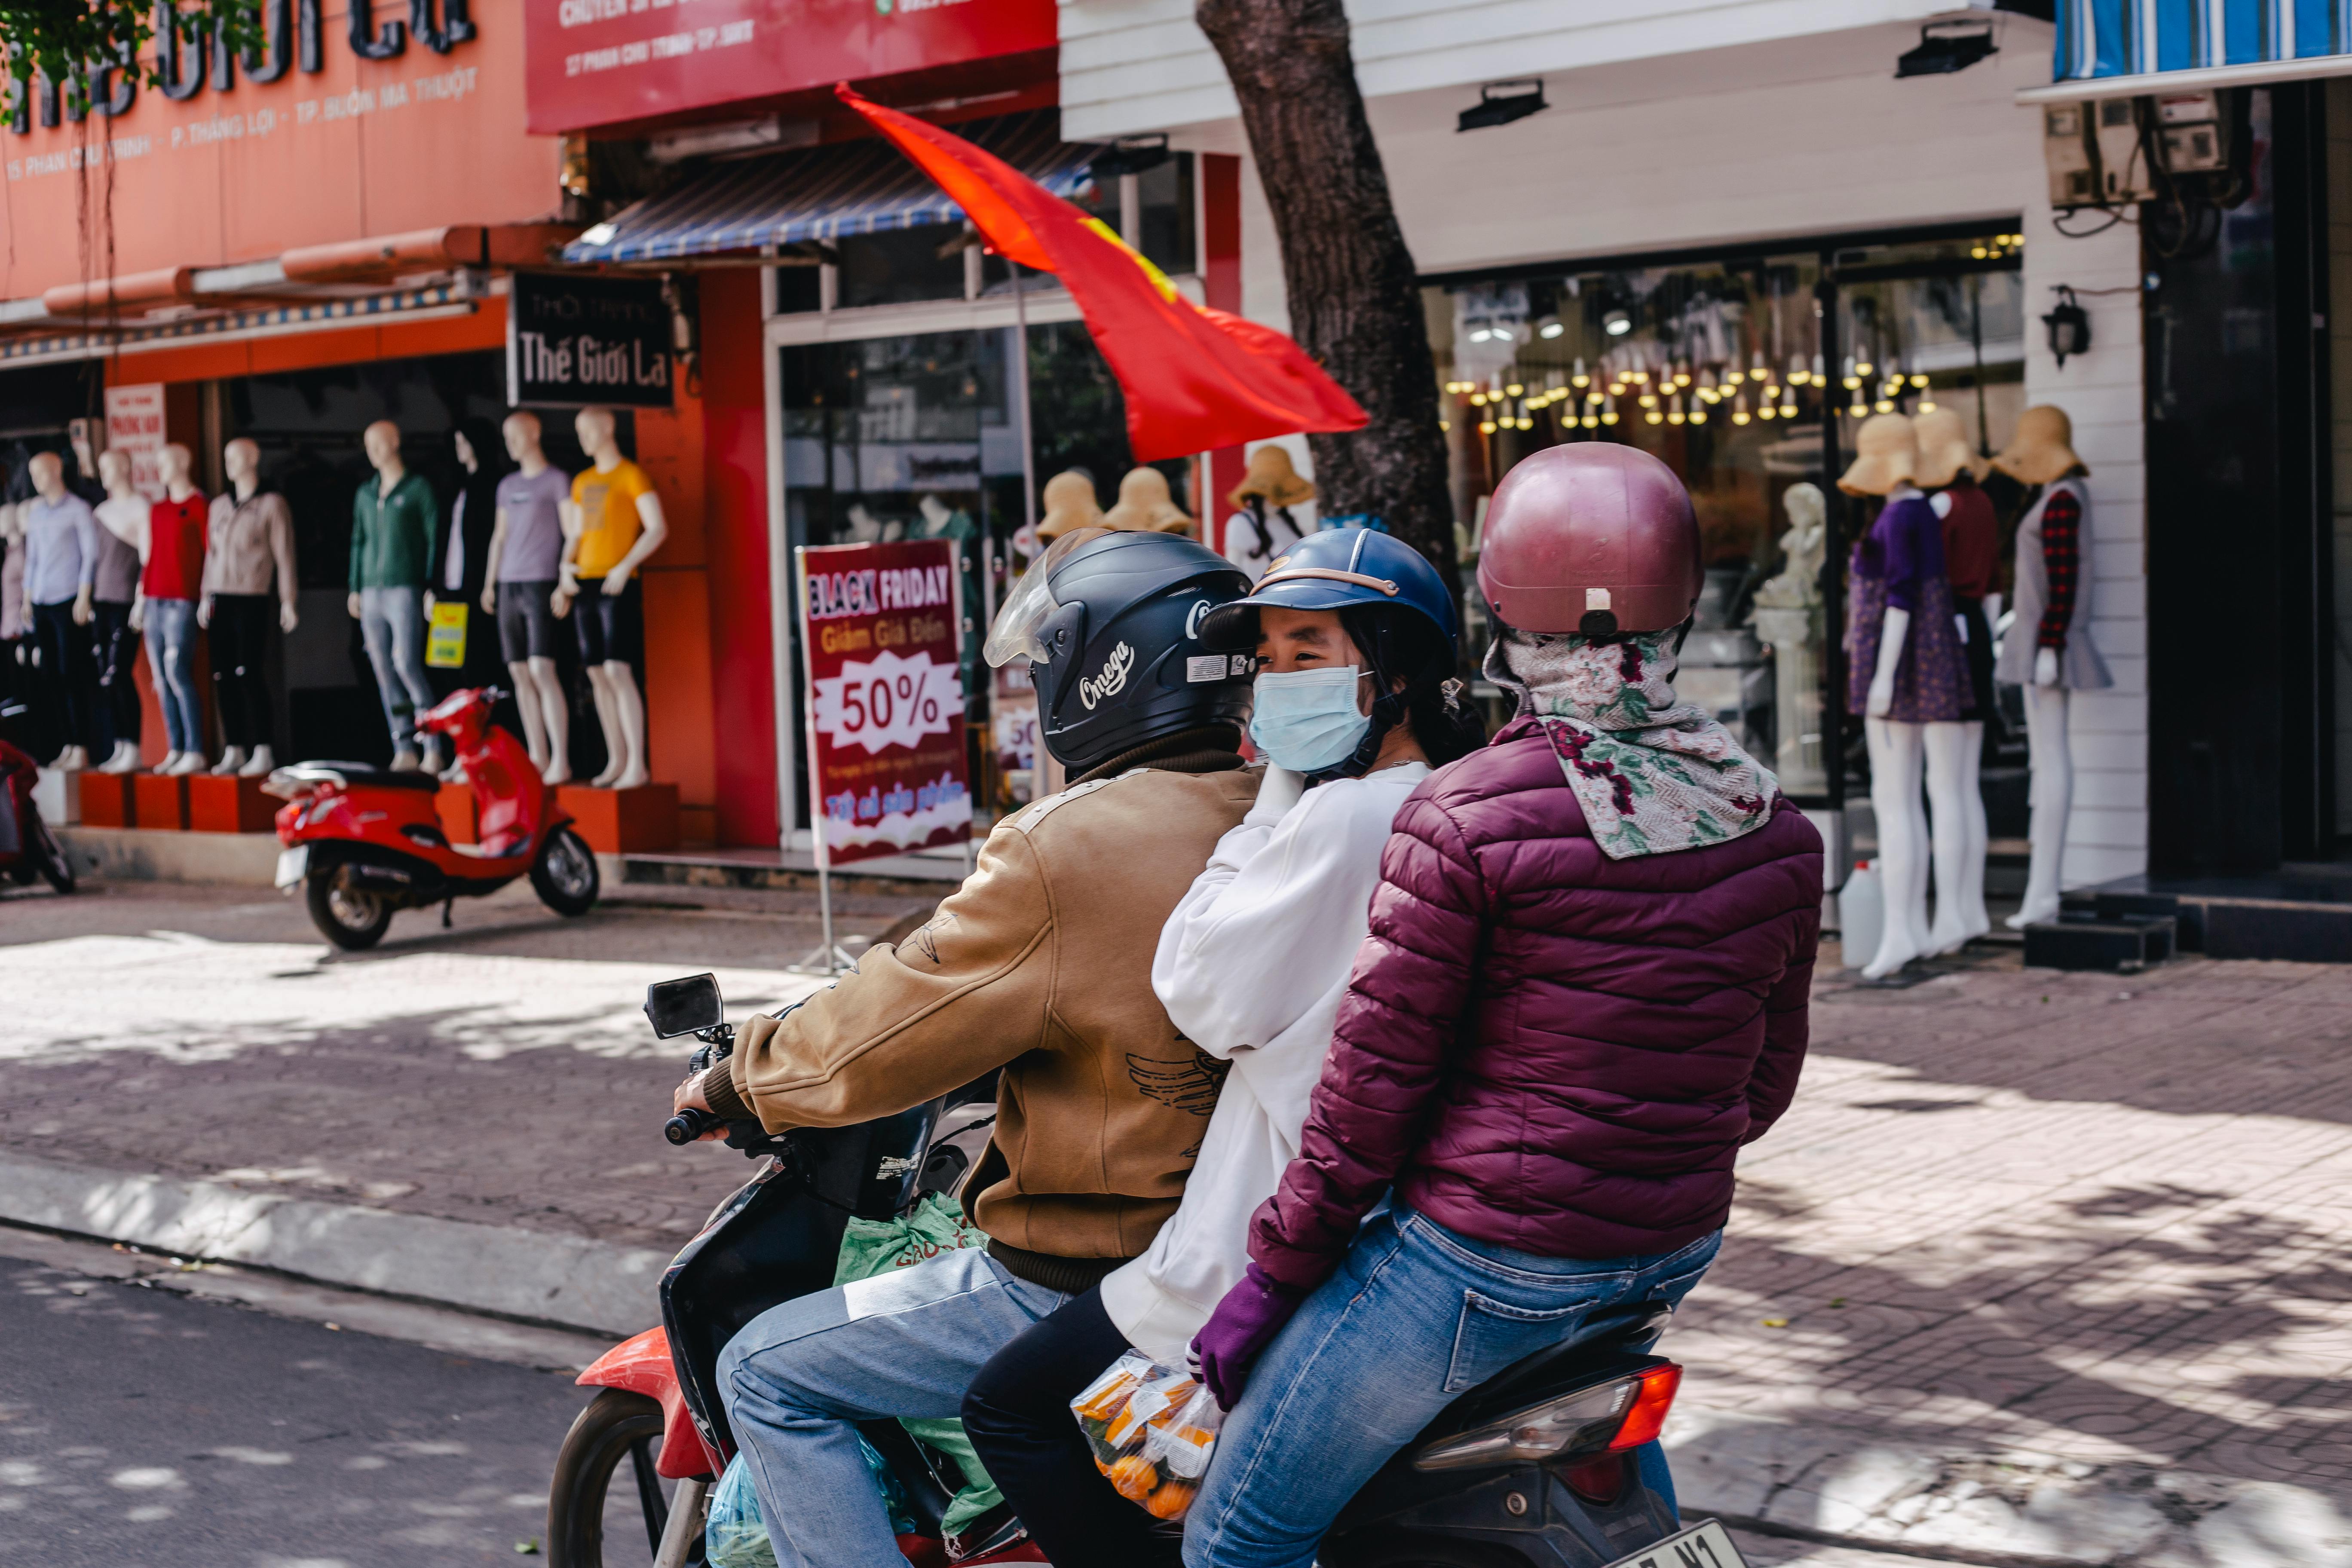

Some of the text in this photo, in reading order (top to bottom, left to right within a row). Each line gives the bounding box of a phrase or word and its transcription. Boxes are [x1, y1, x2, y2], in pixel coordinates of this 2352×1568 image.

[25, 152, 66, 177] PHAN
[107, 133, 151, 160] TRINH
[380, 83, 410, 108] MA
[520, 331, 573, 383] Thế
[578, 334, 629, 385] Giới
[807, 564, 948, 620] BLACK FRIDAY
[842, 671, 939, 732] 50%
[1079, 640, 1135, 710] Omega
